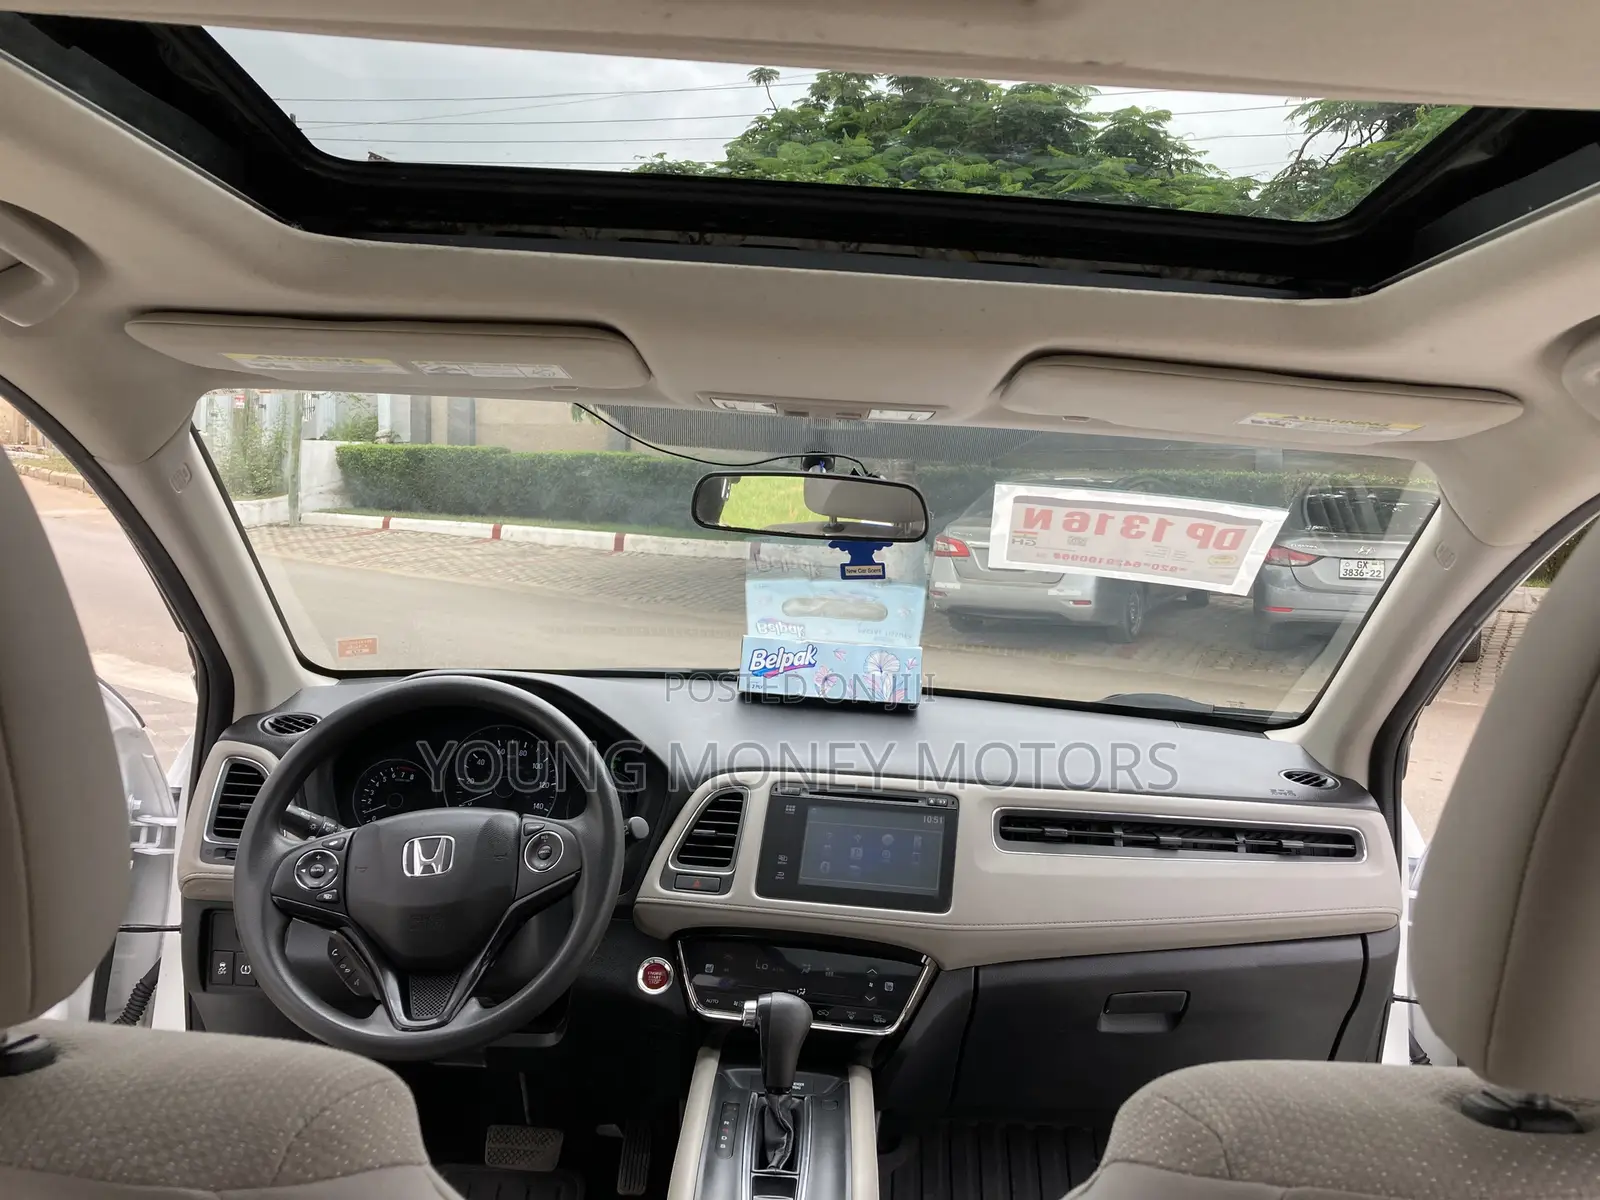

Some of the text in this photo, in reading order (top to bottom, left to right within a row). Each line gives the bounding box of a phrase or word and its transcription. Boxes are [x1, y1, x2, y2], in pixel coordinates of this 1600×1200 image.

[1356, 561, 1369, 569] GX
[1342, 568, 1382, 578] 3836-22
[749, 643, 818, 675] Belpak
[477, 758, 486, 766] 40
[532, 762, 544, 770] 100
[539, 781, 550, 789] 120
[533, 802, 544, 810] 140
[922, 815, 944, 825] 10:51
